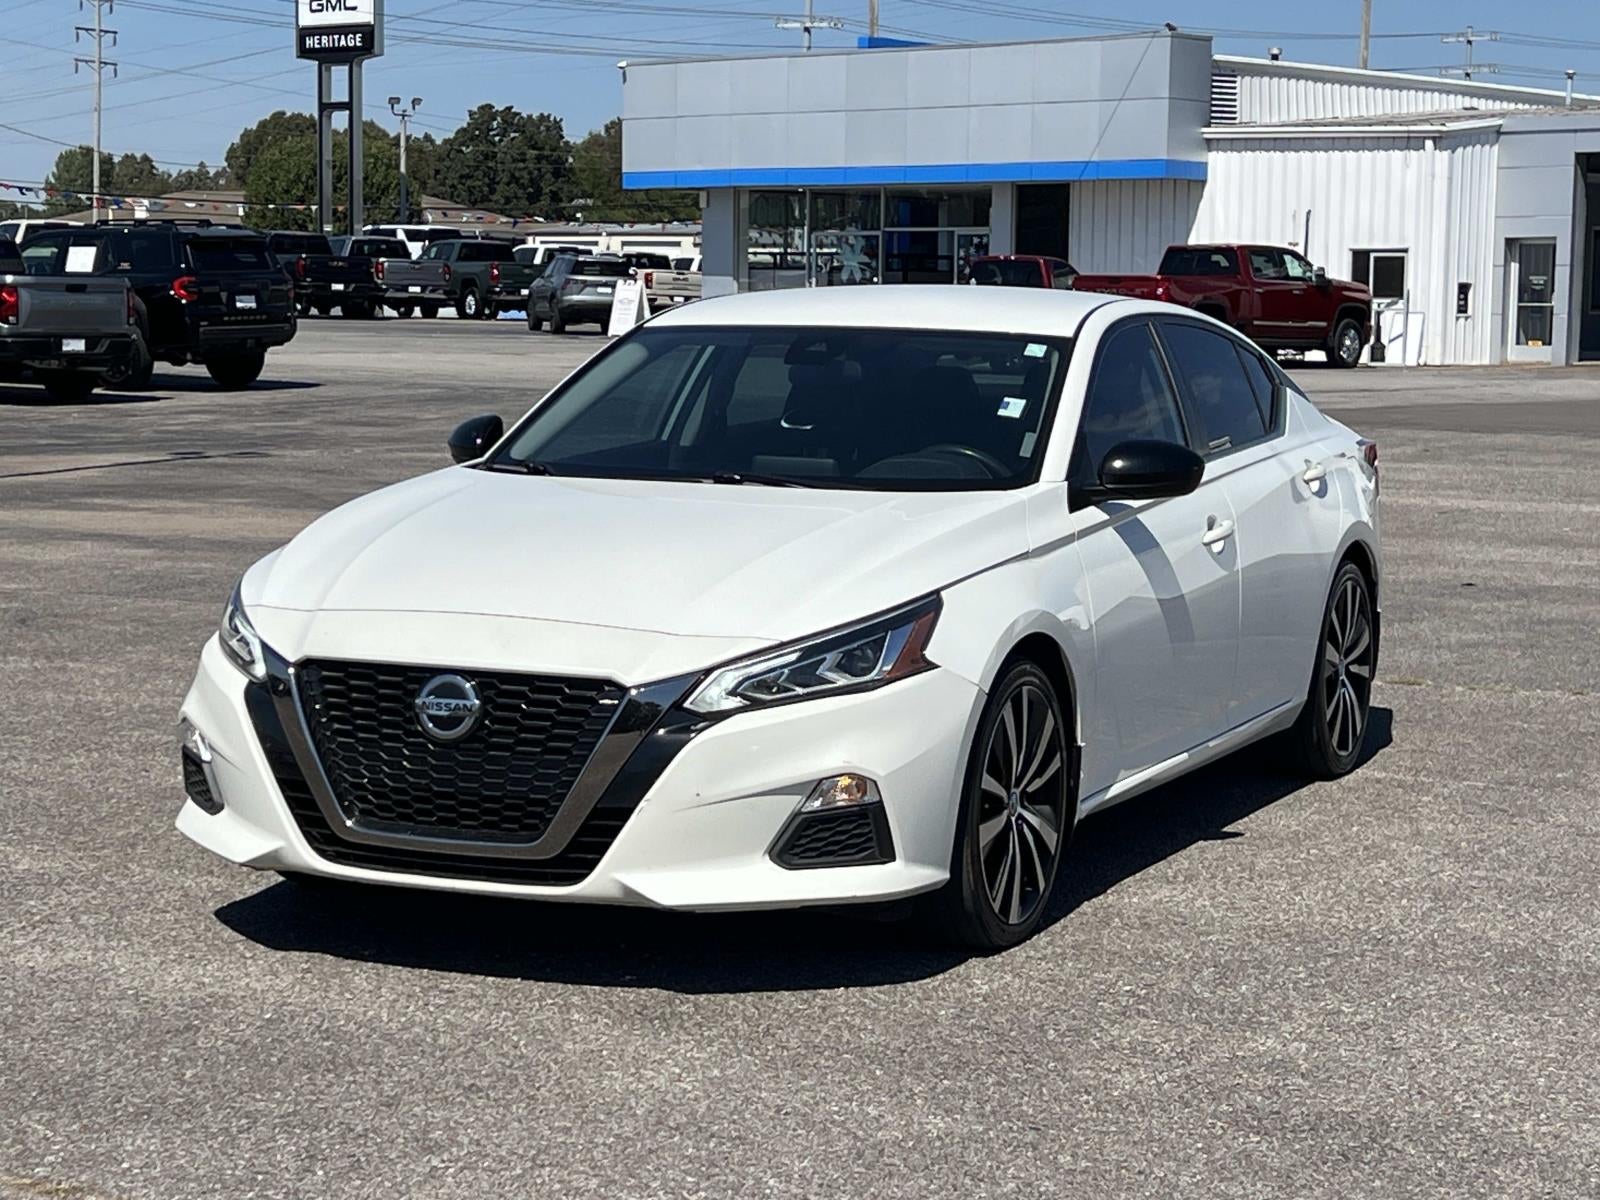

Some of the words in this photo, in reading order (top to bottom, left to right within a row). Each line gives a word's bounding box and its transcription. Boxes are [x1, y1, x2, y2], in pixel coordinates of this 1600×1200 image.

[309, 0, 358, 12] GMC
[305, 34, 363, 48] HERITAGE
[421, 701, 473, 712] NISSAN
